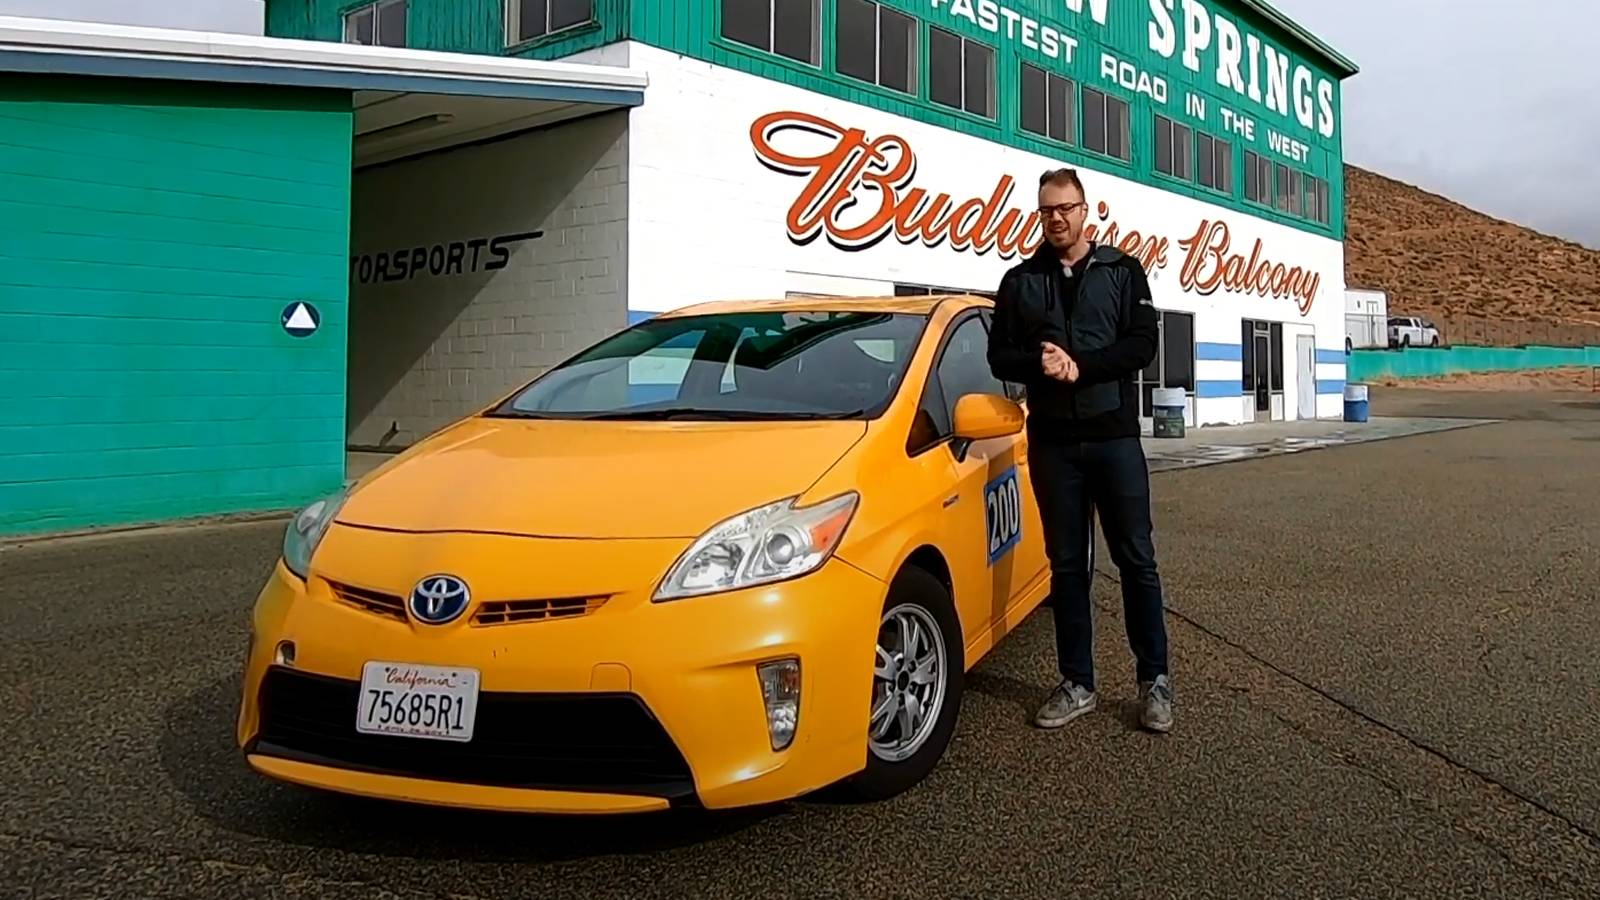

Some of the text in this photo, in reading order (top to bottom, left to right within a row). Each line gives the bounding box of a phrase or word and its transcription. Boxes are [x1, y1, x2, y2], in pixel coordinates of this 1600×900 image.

[931, 0, 1078, 64] ASTEST
[1100, 53, 1168, 104] ROAD
[1185, 92, 1206, 121] IN
[1220, 107, 1255, 140] THE
[1267, 128, 1310, 163] WEST
[1148, 0, 1334, 138] SPRINGS
[749, 110, 1320, 316] Budwiser Balcony
[987, 477, 1019, 554] 200
[368, 689, 464, 730] 75685R1
[385, 666, 456, 690] California
